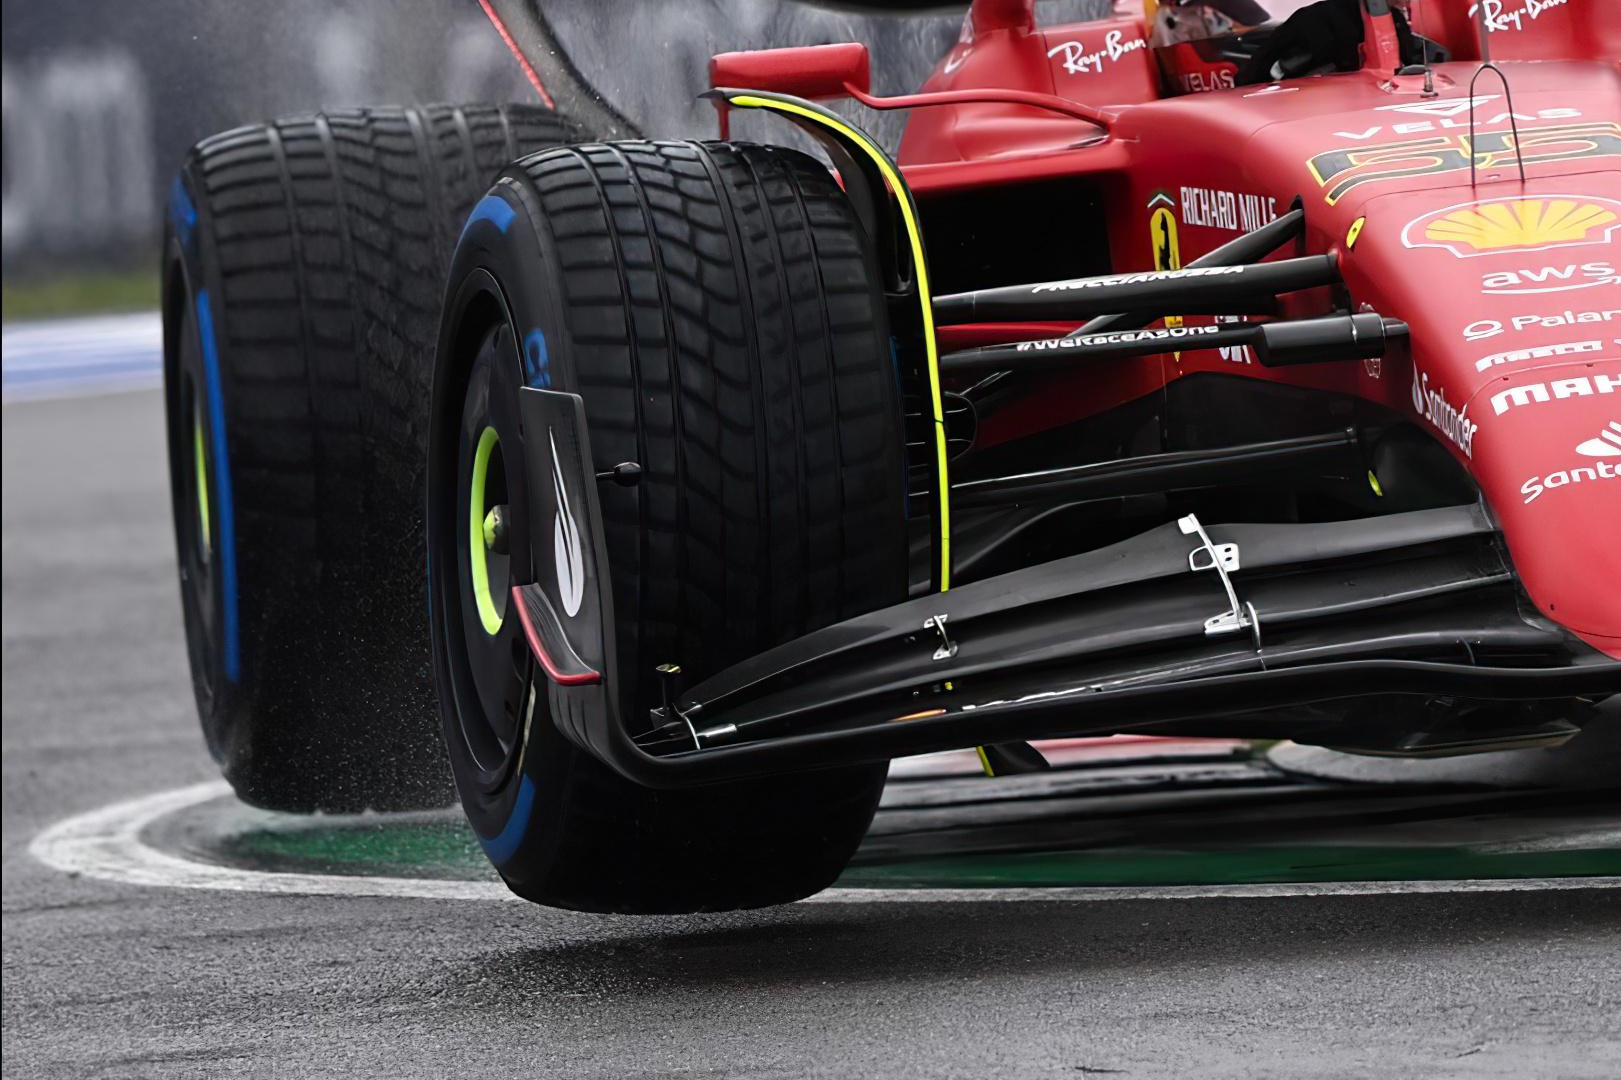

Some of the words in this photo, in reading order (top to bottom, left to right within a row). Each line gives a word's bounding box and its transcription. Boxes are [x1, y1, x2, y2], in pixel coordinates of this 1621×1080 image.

[1047, 30, 1147, 74] Ray-Ban
[1332, 108, 1582, 139] VELAS
[1180, 186, 1237, 230] RICHARD
[1481, 262, 1618, 288] aws
[1016, 324, 1219, 351] #WeRaceAsOne
